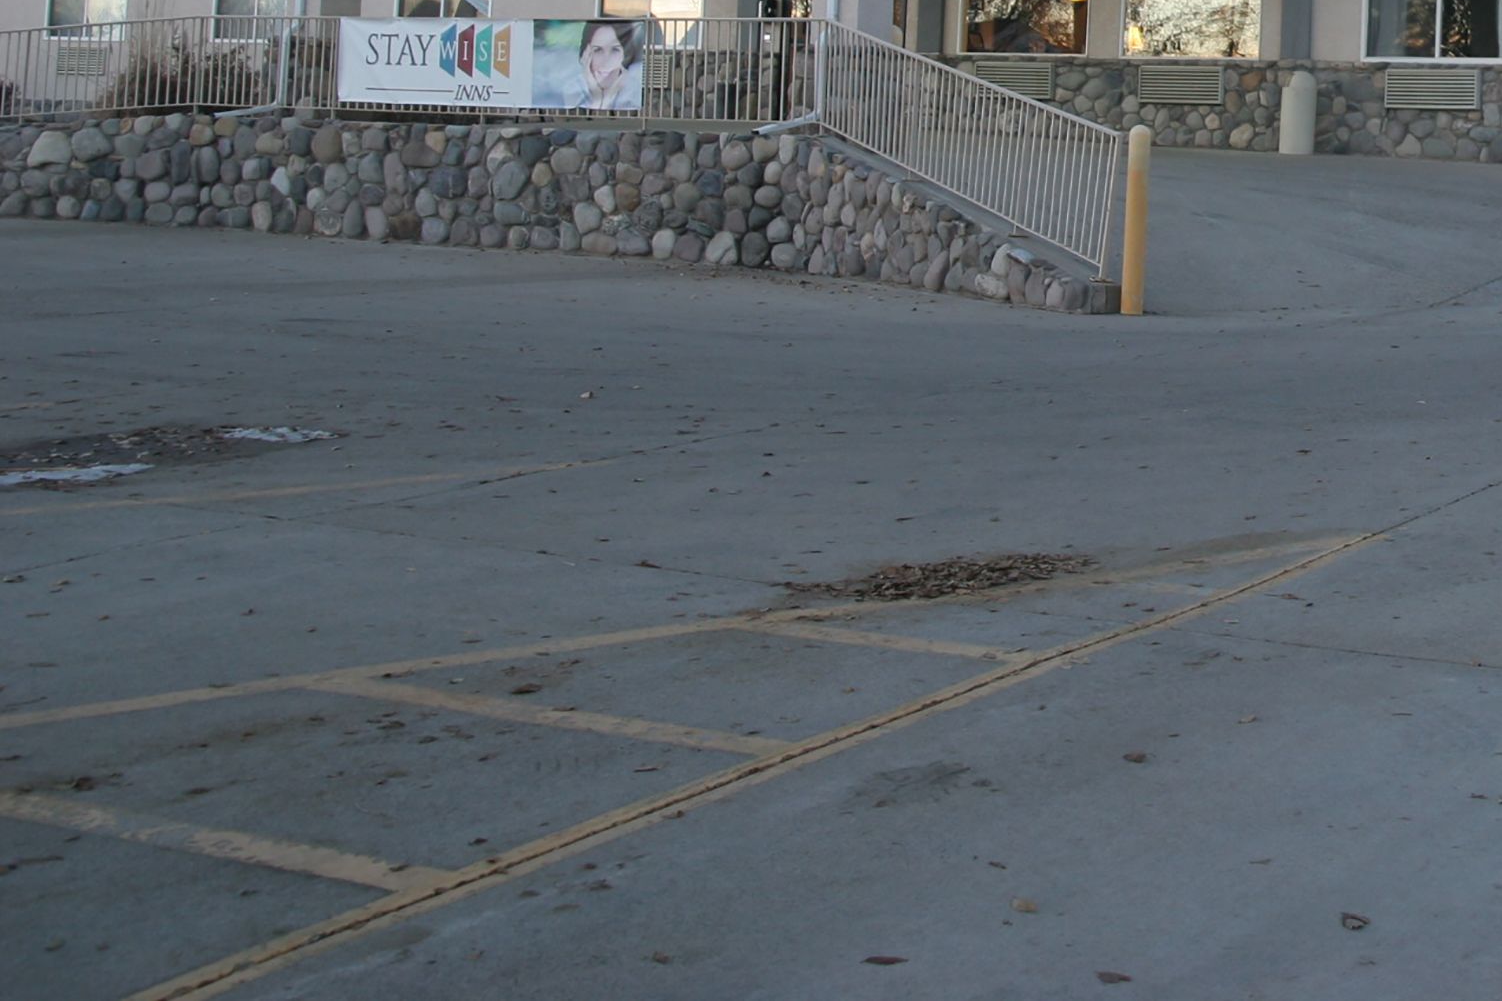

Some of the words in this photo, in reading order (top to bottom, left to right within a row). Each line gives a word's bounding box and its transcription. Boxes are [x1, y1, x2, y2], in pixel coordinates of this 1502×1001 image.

[366, 33, 436, 66] STAY
[440, 41, 507, 62] WISE
[455, 84, 493, 102] INNS
